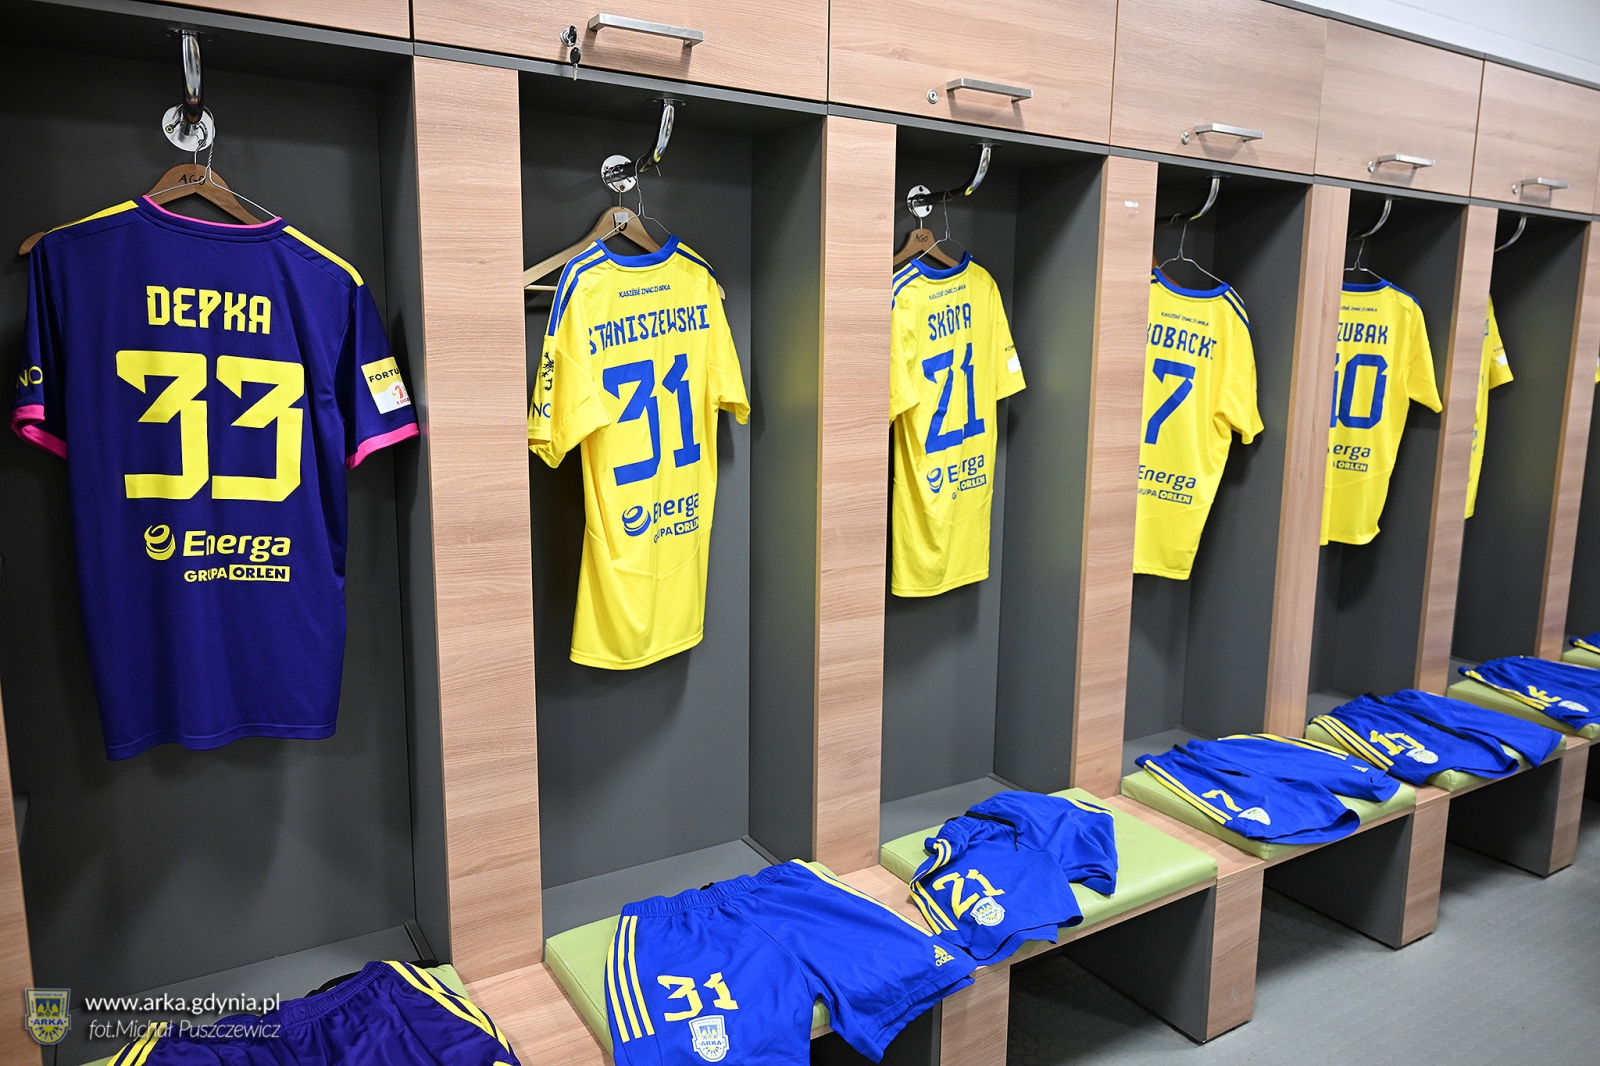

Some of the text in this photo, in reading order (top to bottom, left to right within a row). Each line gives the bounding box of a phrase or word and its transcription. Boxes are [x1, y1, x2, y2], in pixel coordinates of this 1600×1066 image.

[146, 285, 271, 334] DEPKA
[1146, 322, 1217, 360] OBACKI
[1337, 322, 1389, 345] ZUBAK
[921, 341, 986, 455] 21
[1144, 357, 1196, 445] 7
[116, 350, 304, 502] 33
[602, 353, 700, 486] 31
[947, 454, 985, 483] Erga
[960, 475, 986, 490] ORLEN
[1138, 464, 1197, 491] Energa
[1337, 460, 1368, 472] ORLEN
[1159, 490, 1192, 504] ORLEN
[183, 530, 292, 562] Energa
[231, 566, 287, 580] ORLEN
[932, 868, 1005, 919] 21
[657, 971, 740, 1022] 31
